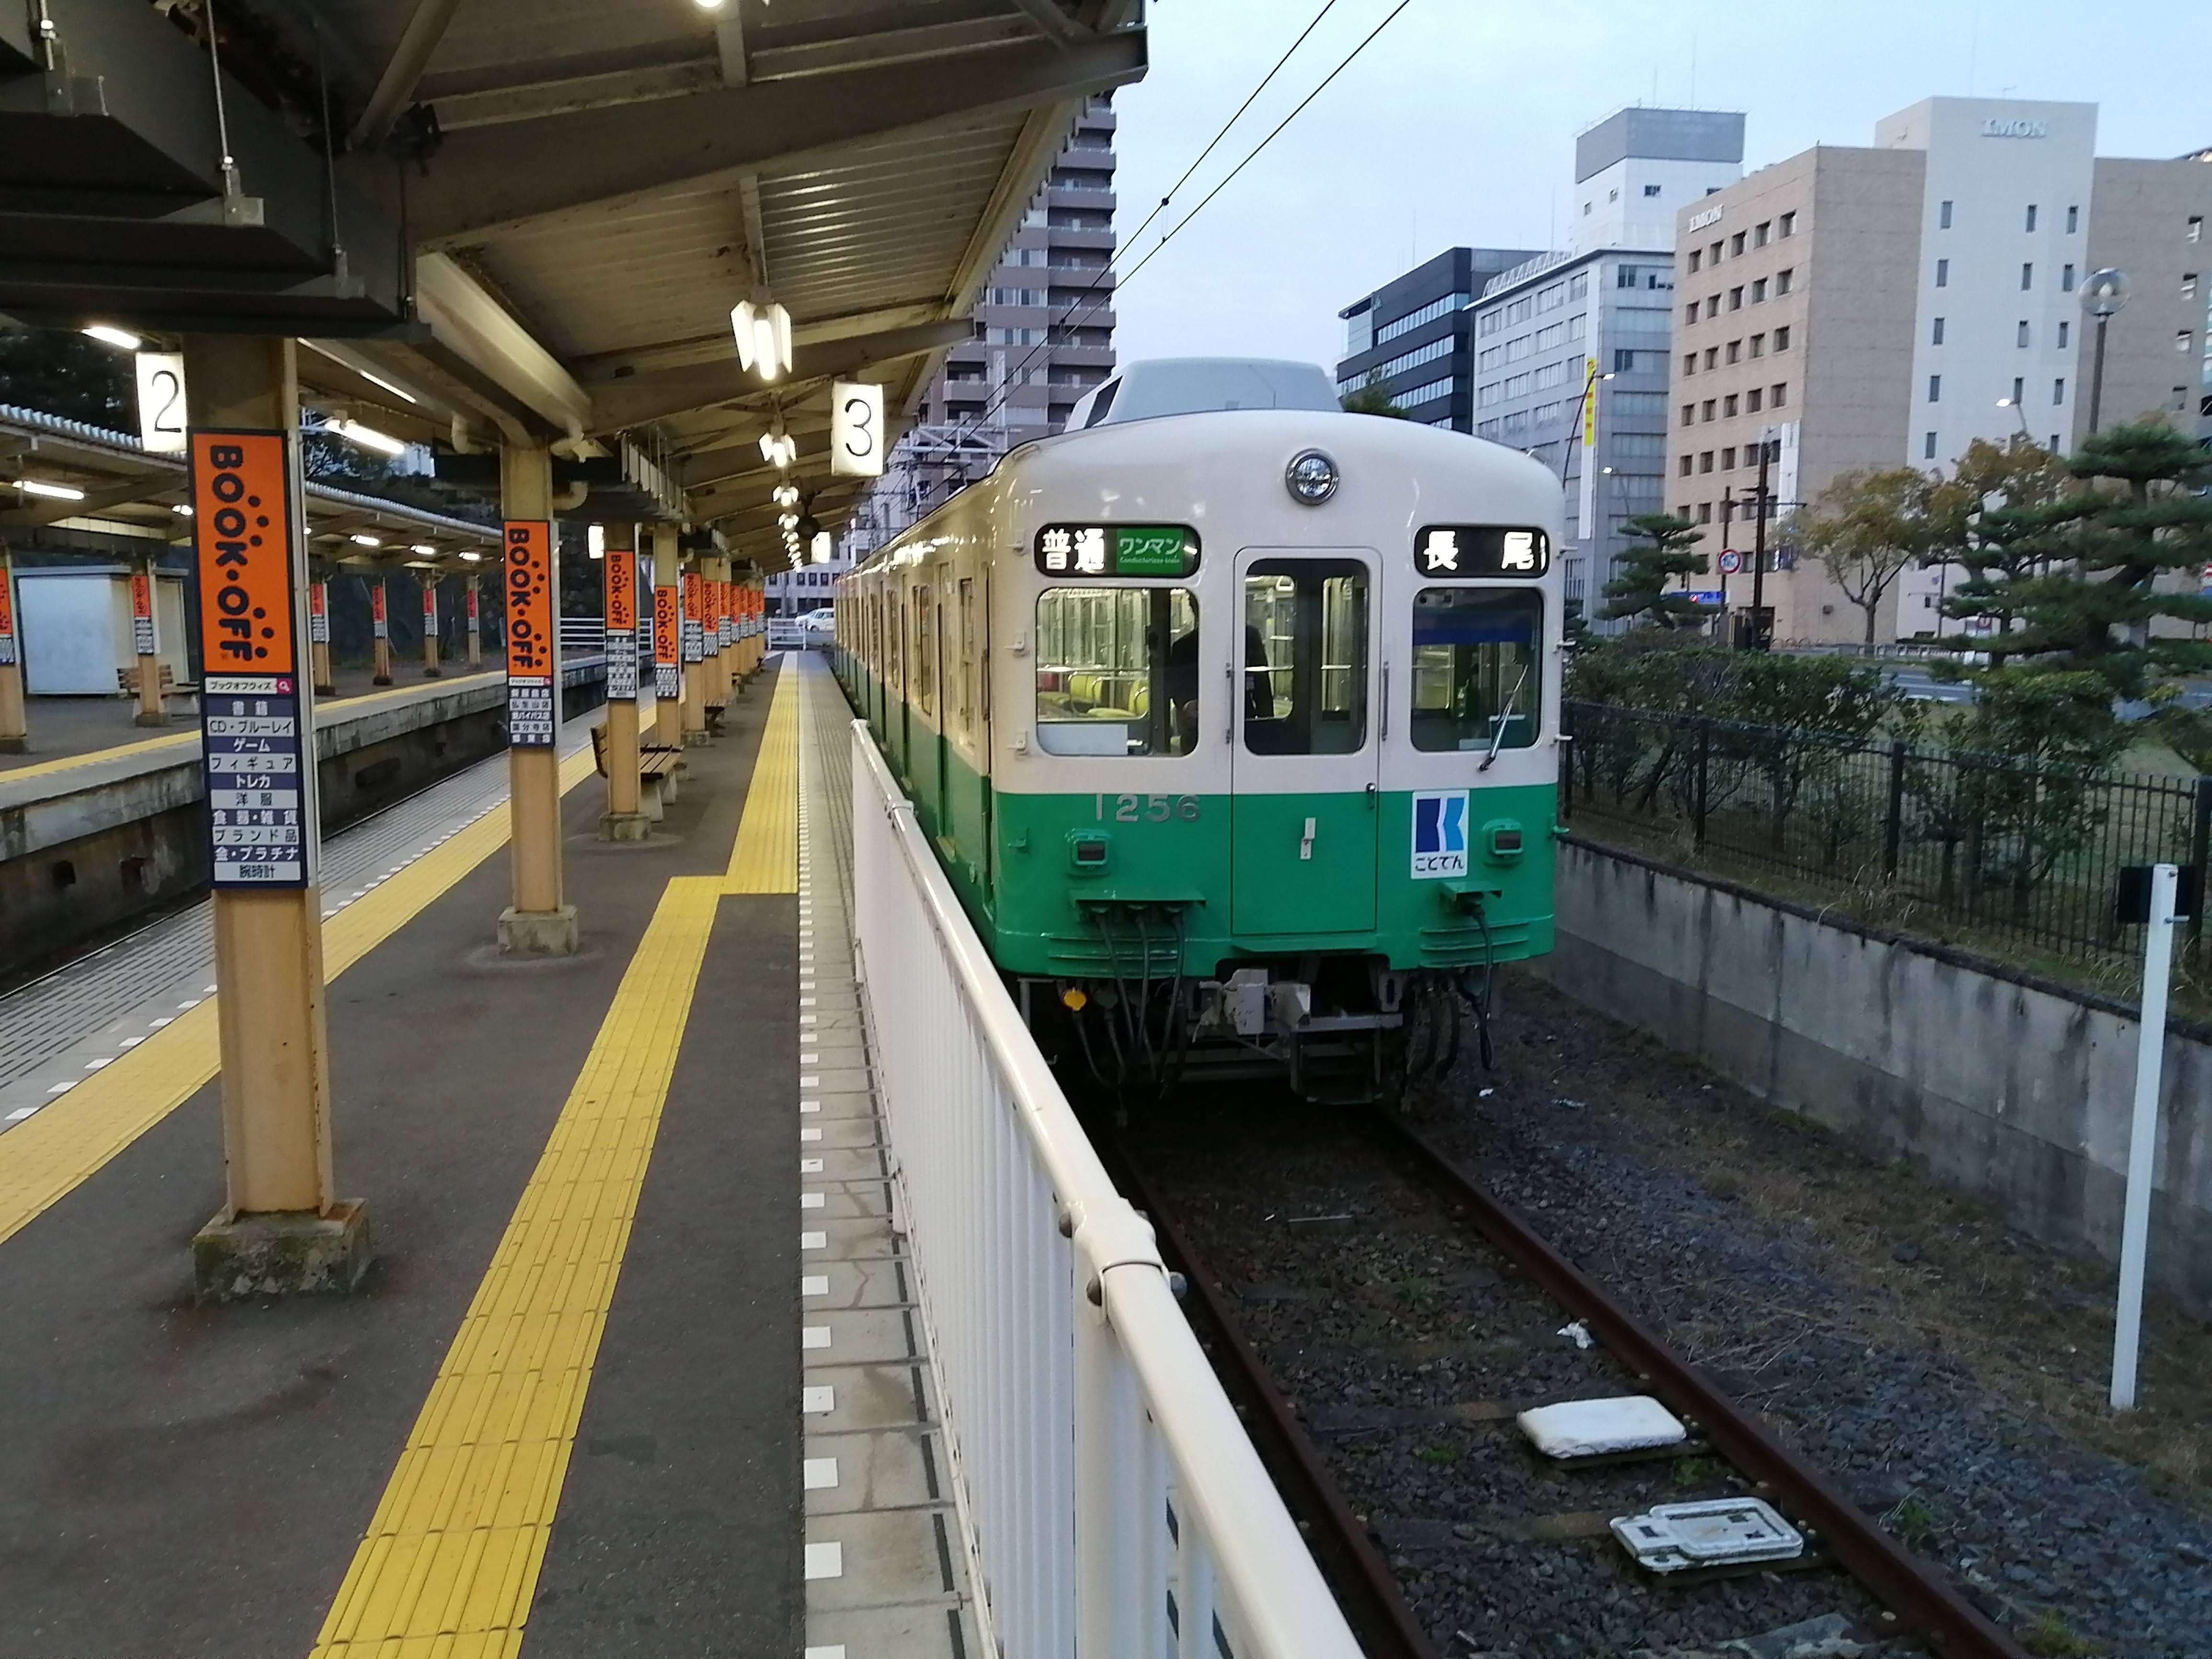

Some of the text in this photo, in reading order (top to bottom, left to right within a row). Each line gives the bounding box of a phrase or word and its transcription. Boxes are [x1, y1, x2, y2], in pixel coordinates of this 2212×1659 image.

[152, 370, 182, 433] 2
[845, 398, 872, 457] 3
[1042, 528, 1105, 574] 普通
[1119, 537, 1180, 556] ワンマン
[233, 737, 271, 752] ゲーム
[211, 756, 293, 771] フィギュア
[236, 773, 271, 788] トレカ
[236, 791, 273, 807] 洋服
[1095, 793, 1200, 823] 1256
[215, 829, 297, 842] ブランド品
[1415, 855, 1464, 871] ことでん
